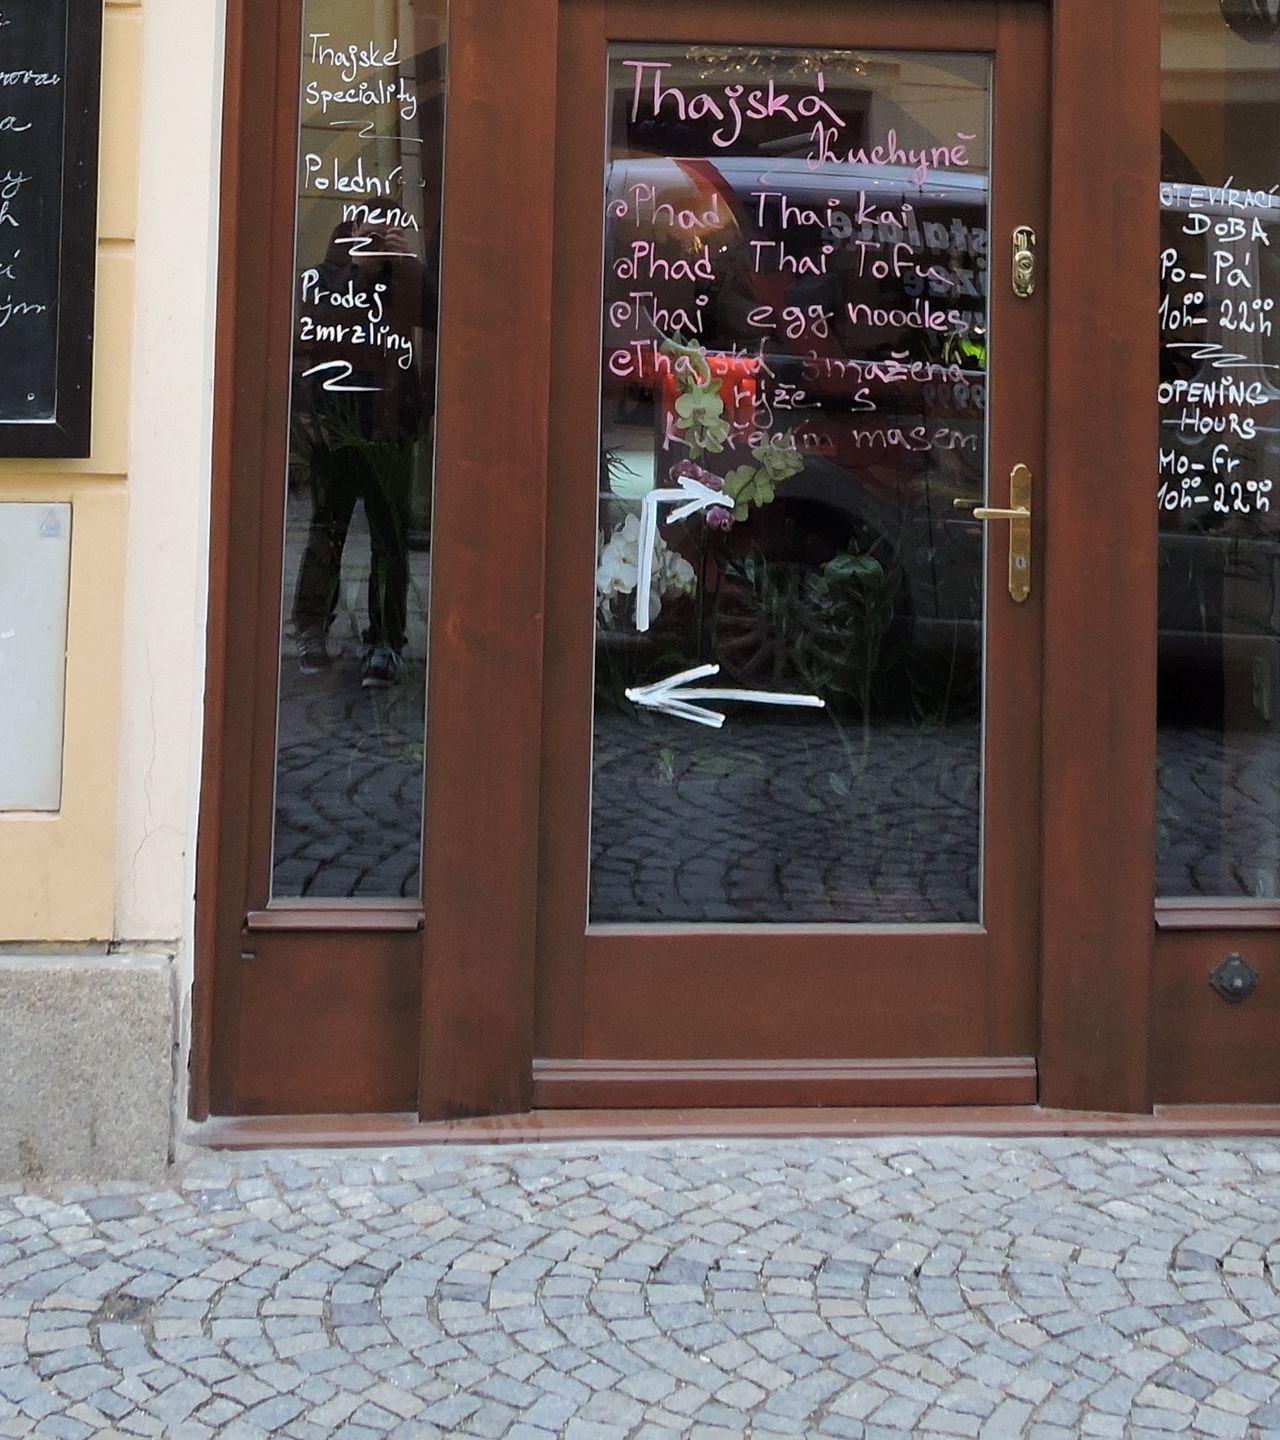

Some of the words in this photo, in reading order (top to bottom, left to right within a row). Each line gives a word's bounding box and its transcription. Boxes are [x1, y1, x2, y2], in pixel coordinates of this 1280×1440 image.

[623, 60, 847, 148] Thajská
[304, 152, 403, 197] Polední
[1159, 174, 1280, 210] OTEVÍRACÍ
[342, 204, 420, 233] menu
[628, 182, 725, 230] Phad
[749, 191, 841, 230] Thai
[630, 240, 717, 282] Phad
[749, 241, 835, 275] Thai
[300, 267, 388, 324] Prodej
[628, 291, 710, 334] Thai
[746, 303, 835, 340] egg
[847, 297, 970, 336] noodles
[732, 378, 823, 430] rýže
[852, 425, 979, 452] masem
